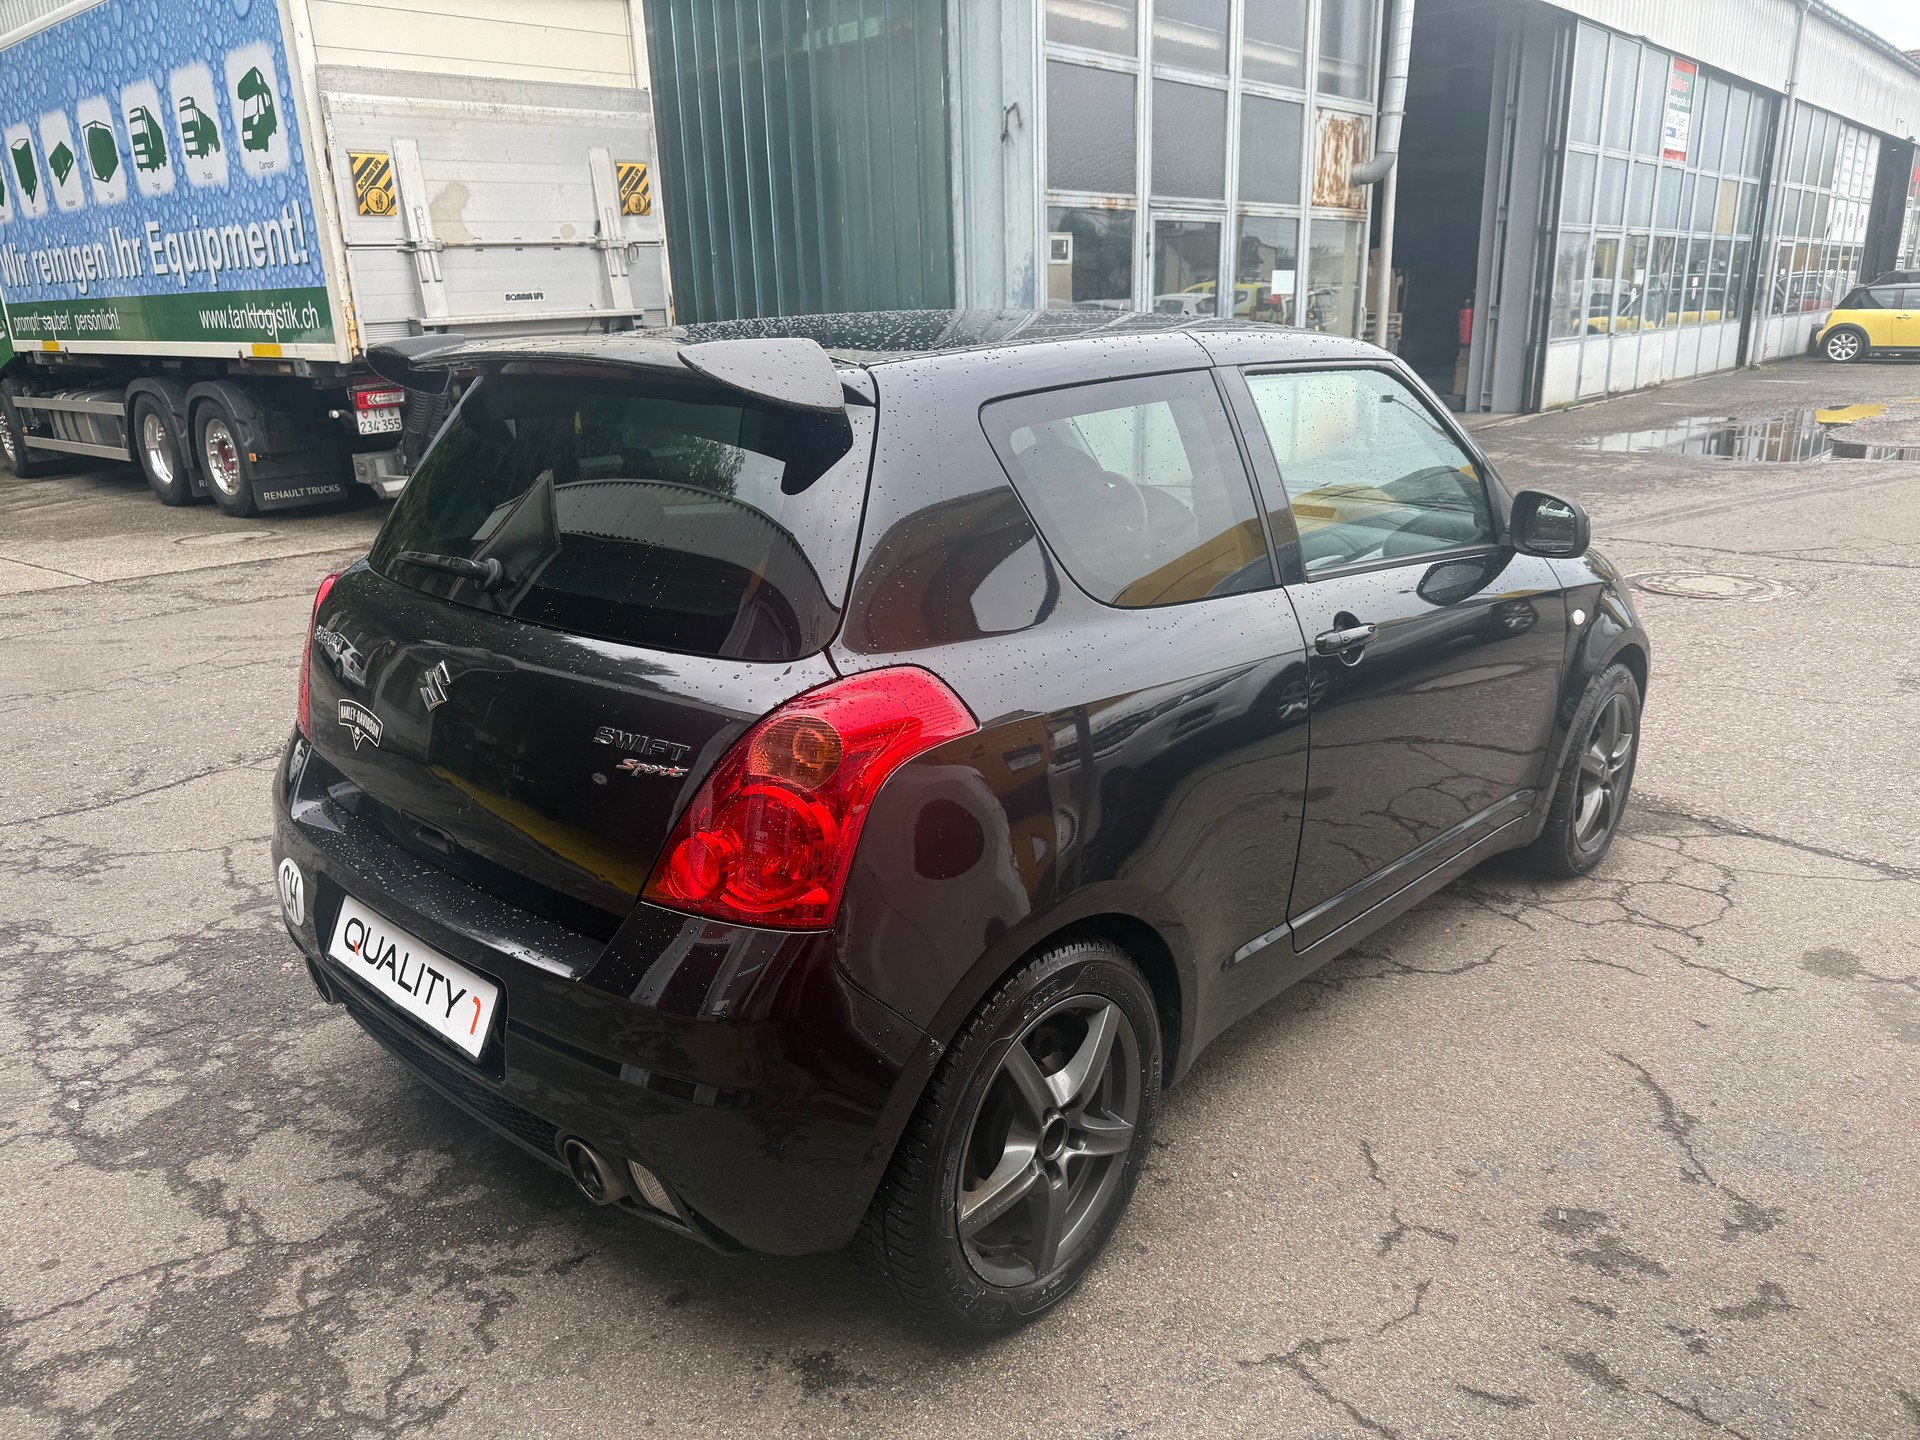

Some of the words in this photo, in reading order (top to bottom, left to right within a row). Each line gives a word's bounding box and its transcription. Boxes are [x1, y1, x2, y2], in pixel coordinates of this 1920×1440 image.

[259, 160, 275, 171] Camper
[0, 243, 30, 287] Wir
[31, 234, 110, 294] reinigen
[108, 226, 142, 280] Ihr
[144, 200, 310, 288] Equipment!
[74, 307, 121, 336] persönlich!
[199, 301, 321, 337] www.tanklogistik.ch
[372, 408, 385, 418] TG
[263, 486, 305, 501] RENAULT
[306, 483, 341, 496] TRUCKS
[340, 704, 380, 739] HARLEY-DAVIDSON
[592, 726, 693, 761] SWIFT
[615, 758, 690, 778] Sport
[282, 864, 300, 922] CH
[343, 917, 468, 1019] QUALITY
[470, 995, 482, 1036] 1
[1021, 978, 1061, 1020] Sava
